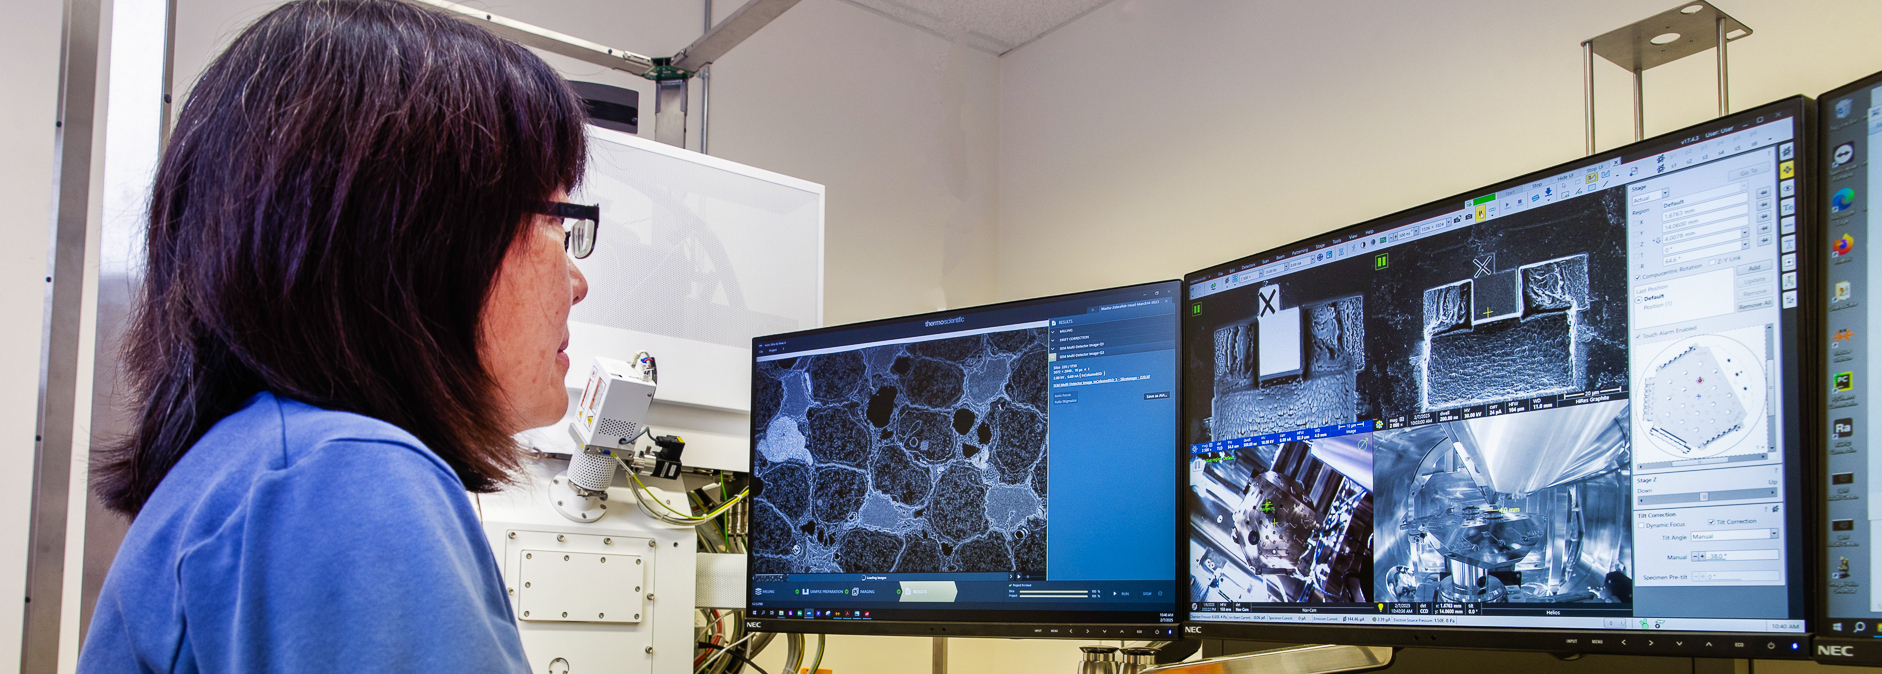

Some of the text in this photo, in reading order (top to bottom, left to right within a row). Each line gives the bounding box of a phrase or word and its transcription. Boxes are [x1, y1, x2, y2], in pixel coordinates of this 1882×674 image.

[1681, 126, 1734, 145] v17.4.3 User: User
[1631, 184, 1646, 193] Stage
[1633, 195, 1649, 204] Actual
[1663, 199, 1684, 209] Default
[1632, 207, 1650, 217] Region
[1642, 263, 1702, 280] Compucentric Rotation
[1744, 276, 1766, 285] Update
[1636, 284, 1668, 295] Last Position
[1743, 289, 1767, 297] Remove
[1644, 293, 1665, 302] Default
[1643, 302, 1664, 310] Position
[1739, 301, 1762, 310] Remove
[1659, 328, 1674, 336] Alarm
[1676, 325, 1697, 333] Enabled
[1837, 376, 1849, 384] PC
[1589, 395, 1610, 403] Graphite
[1835, 423, 1851, 433] Ra
[1817, 645, 1854, 657] NEC
